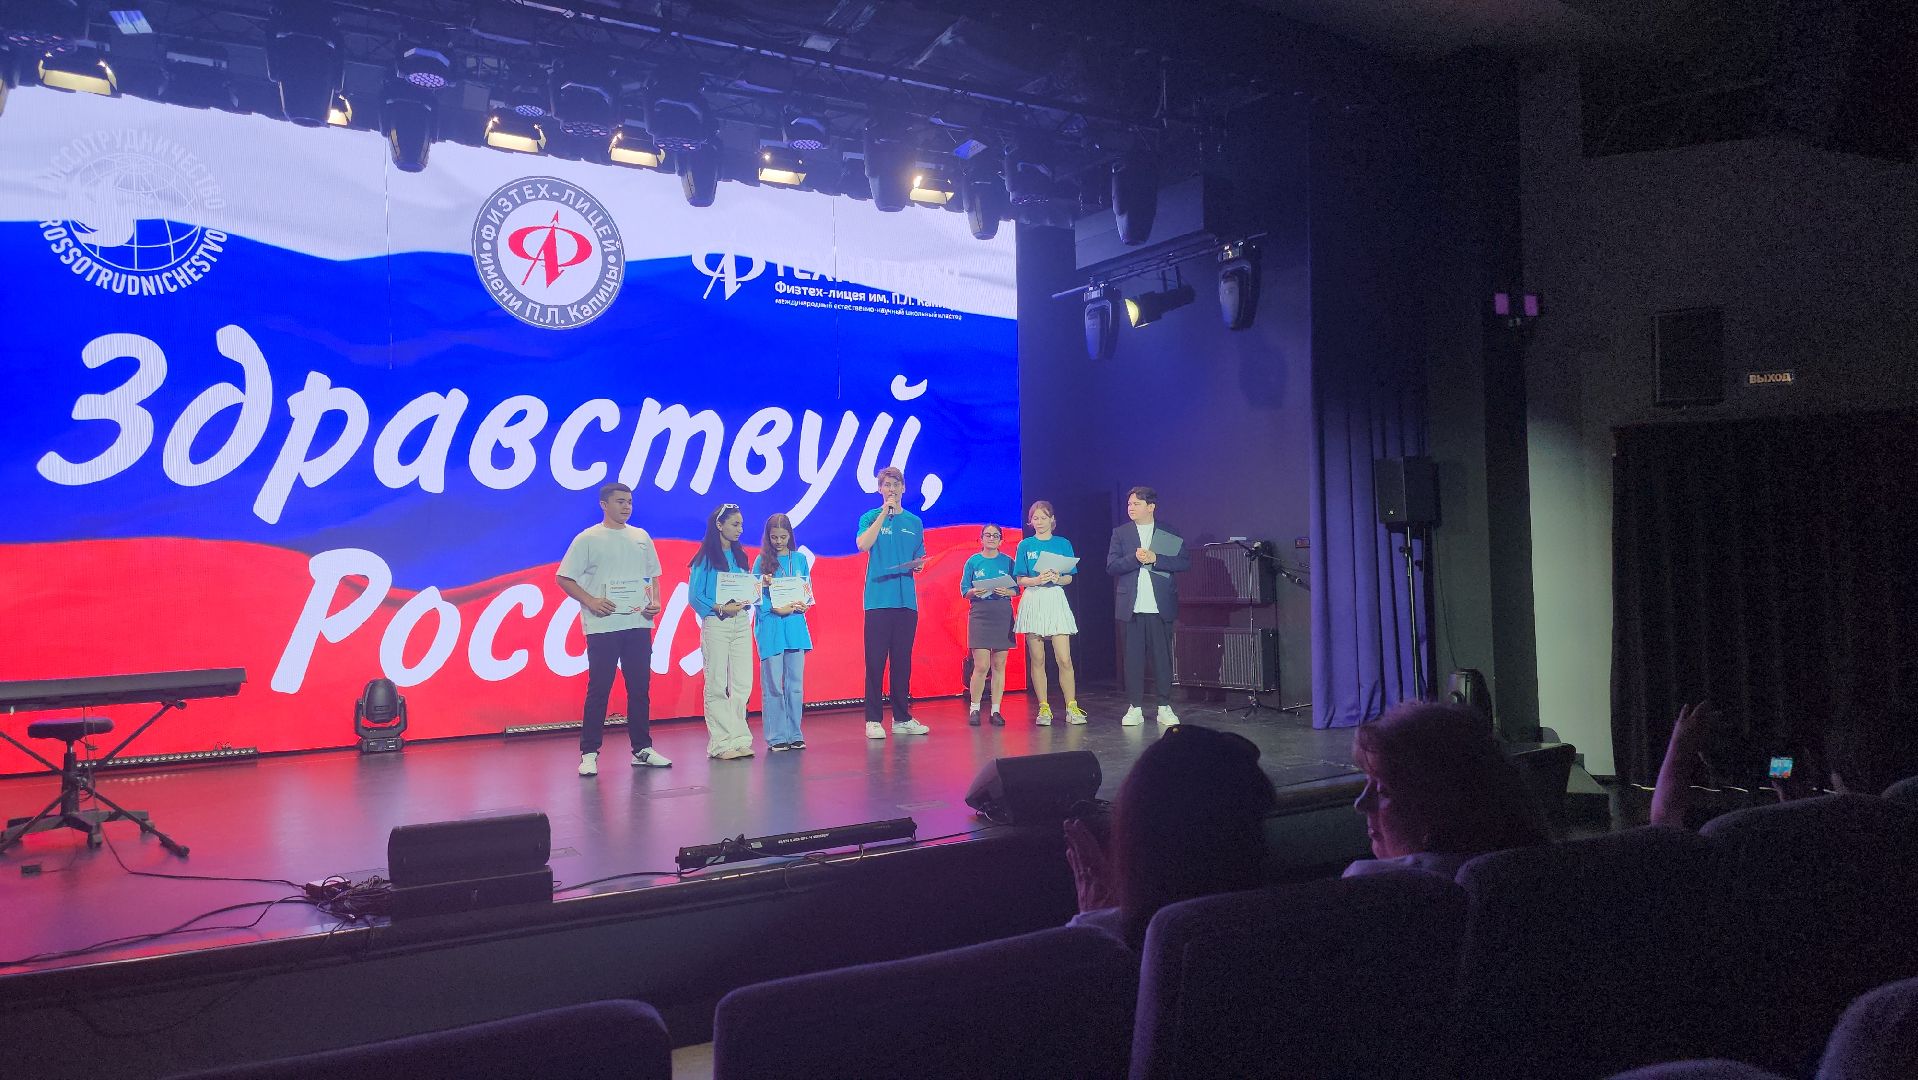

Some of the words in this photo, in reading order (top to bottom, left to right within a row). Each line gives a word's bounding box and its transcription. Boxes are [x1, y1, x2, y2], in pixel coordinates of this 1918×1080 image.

[37, 128, 227, 211] ОССОТРУДНИЧЕСТВО
[480, 183, 622, 253] ФИЗТЕХ-ЛИЦЕЙ
[38, 219, 229, 297] ROSSOTRUDNICHESTVO
[478, 252, 523, 312] имени
[524, 301, 565, 325] П.Л.
[567, 264, 620, 323] Капицы
[774, 280, 866, 302] Физтех-лицея
[868, 292, 890, 304] им.
[1749, 372, 1792, 384] ВЫХОД
[36, 324, 943, 528] Здравствуй,
[271, 545, 816, 694] Росс
